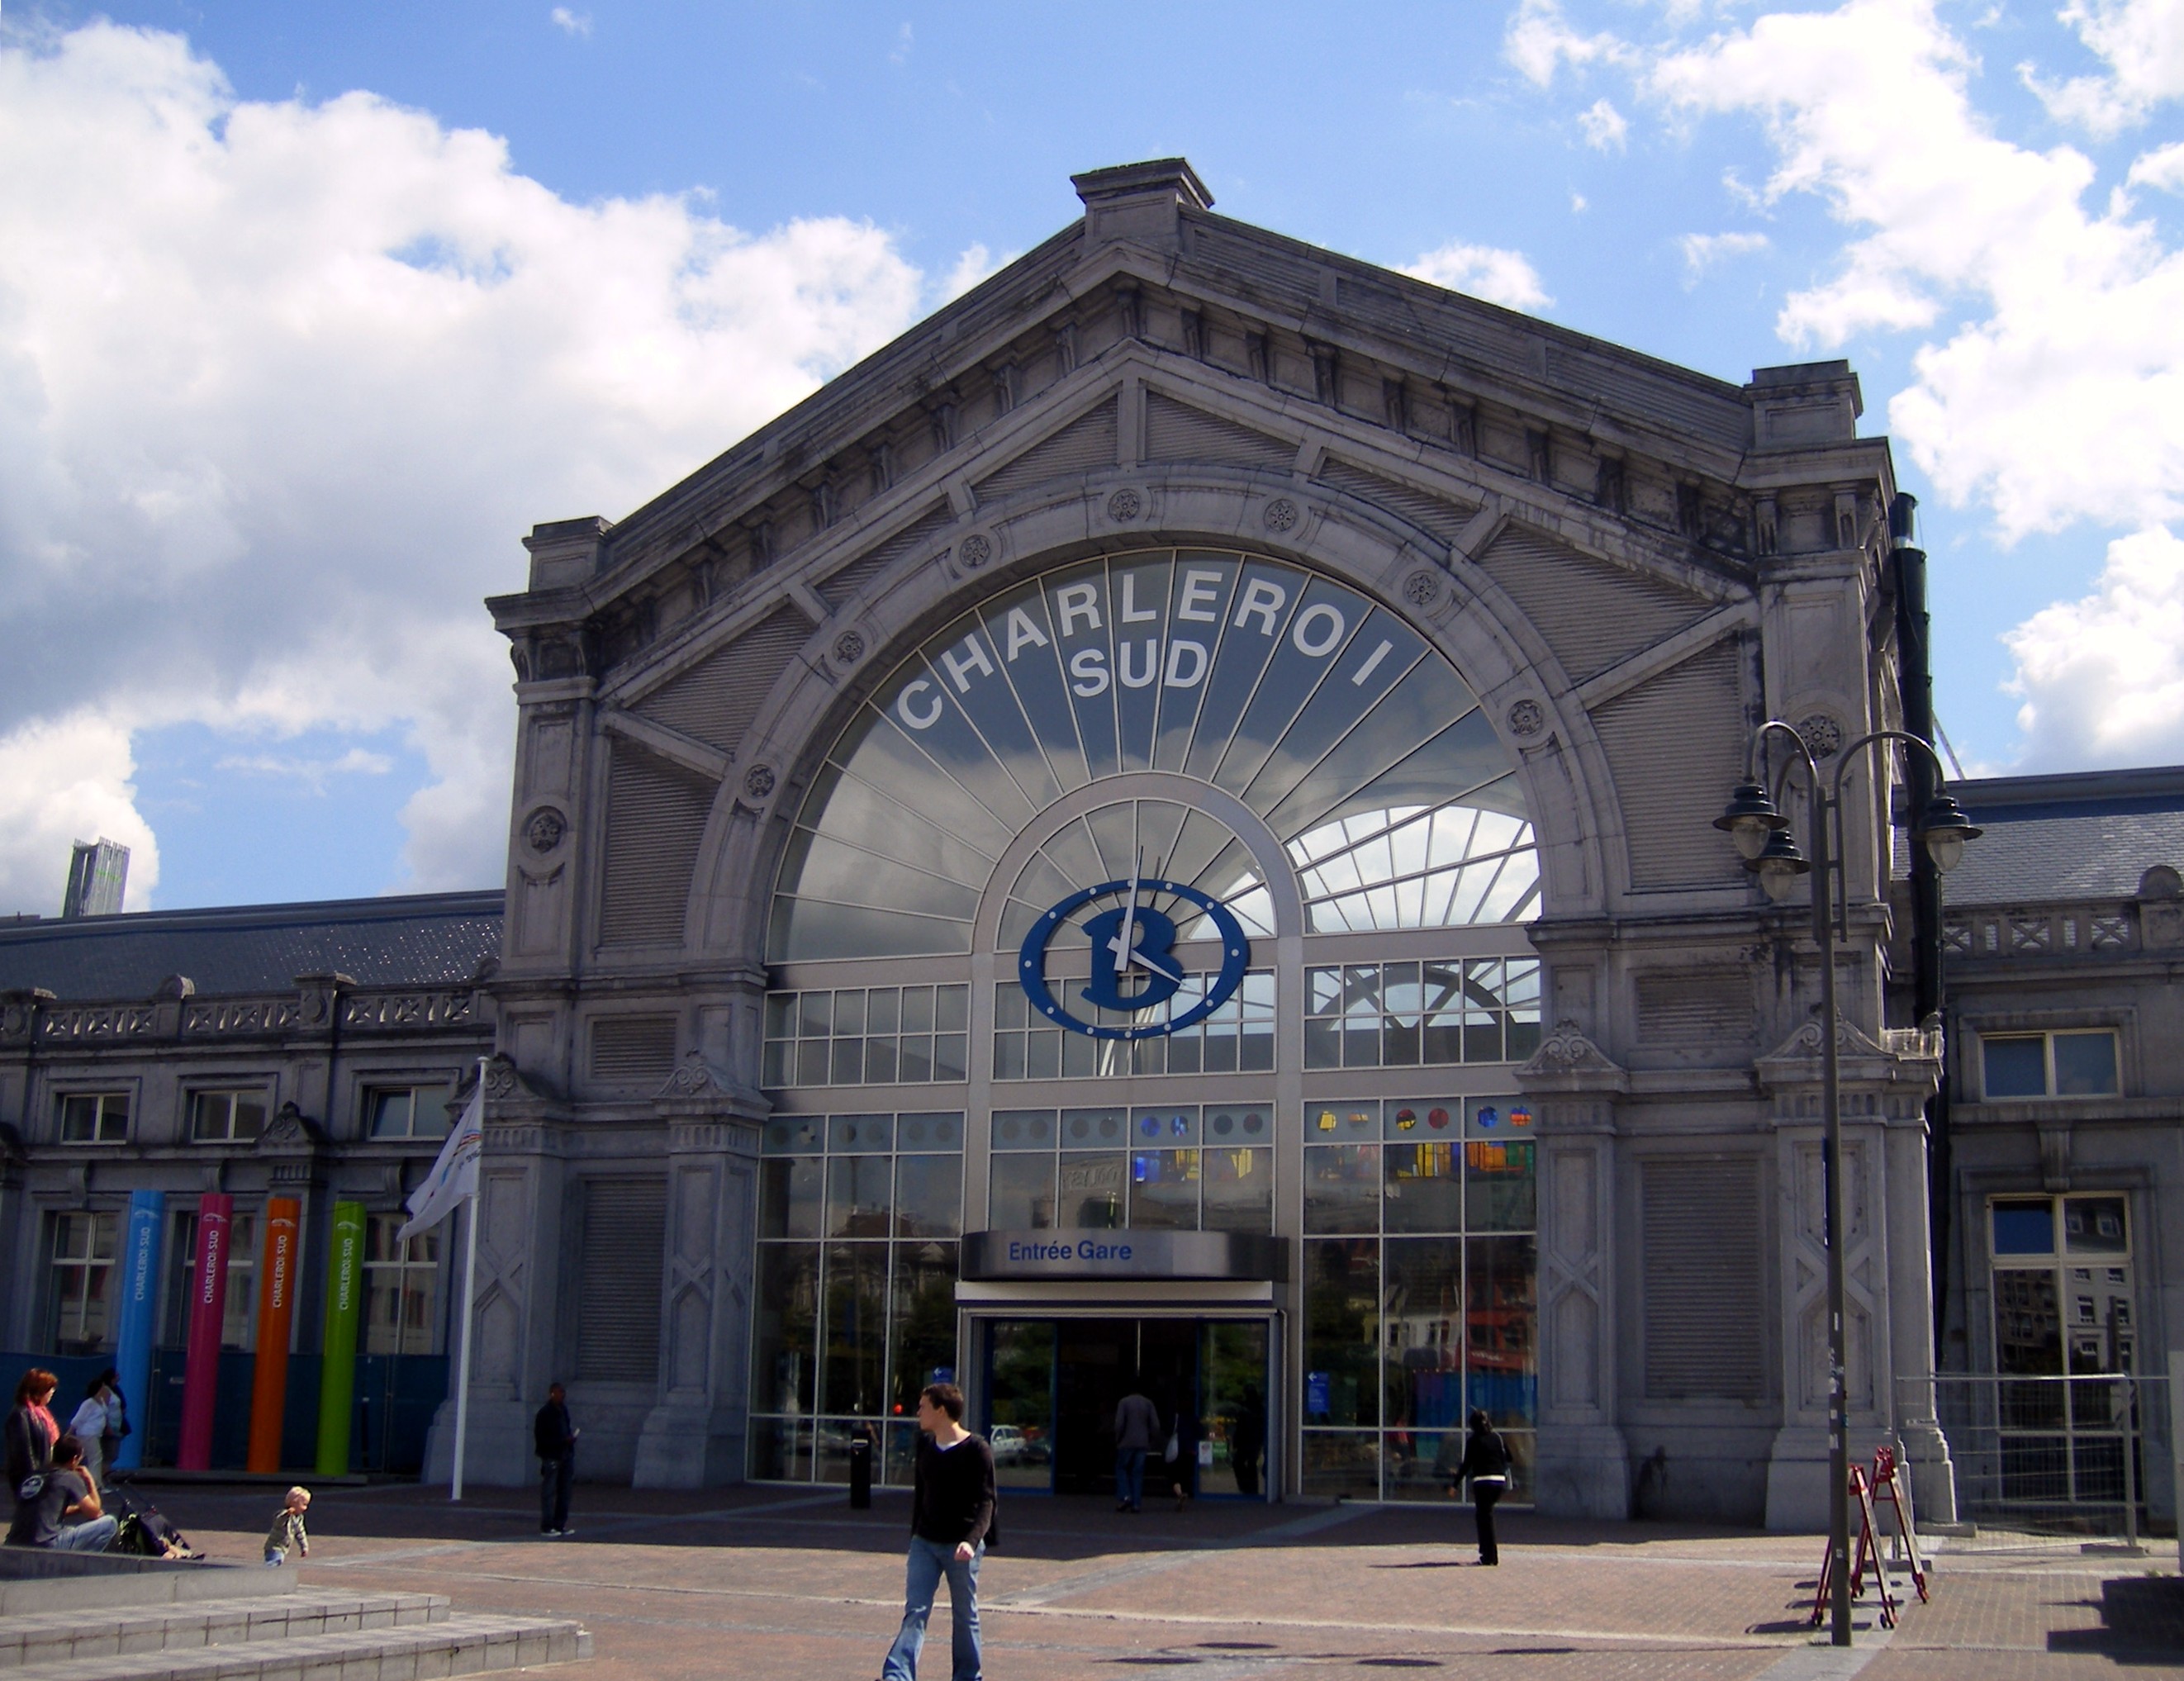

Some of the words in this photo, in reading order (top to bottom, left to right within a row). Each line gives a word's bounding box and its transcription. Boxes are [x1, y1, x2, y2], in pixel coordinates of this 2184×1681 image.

[897, 570, 1393, 729] CHARLEROI
[1071, 639, 1208, 697] SUD
[1009, 1241, 1072, 1261] Entrée
[1077, 1240, 1132, 1260] Gare
